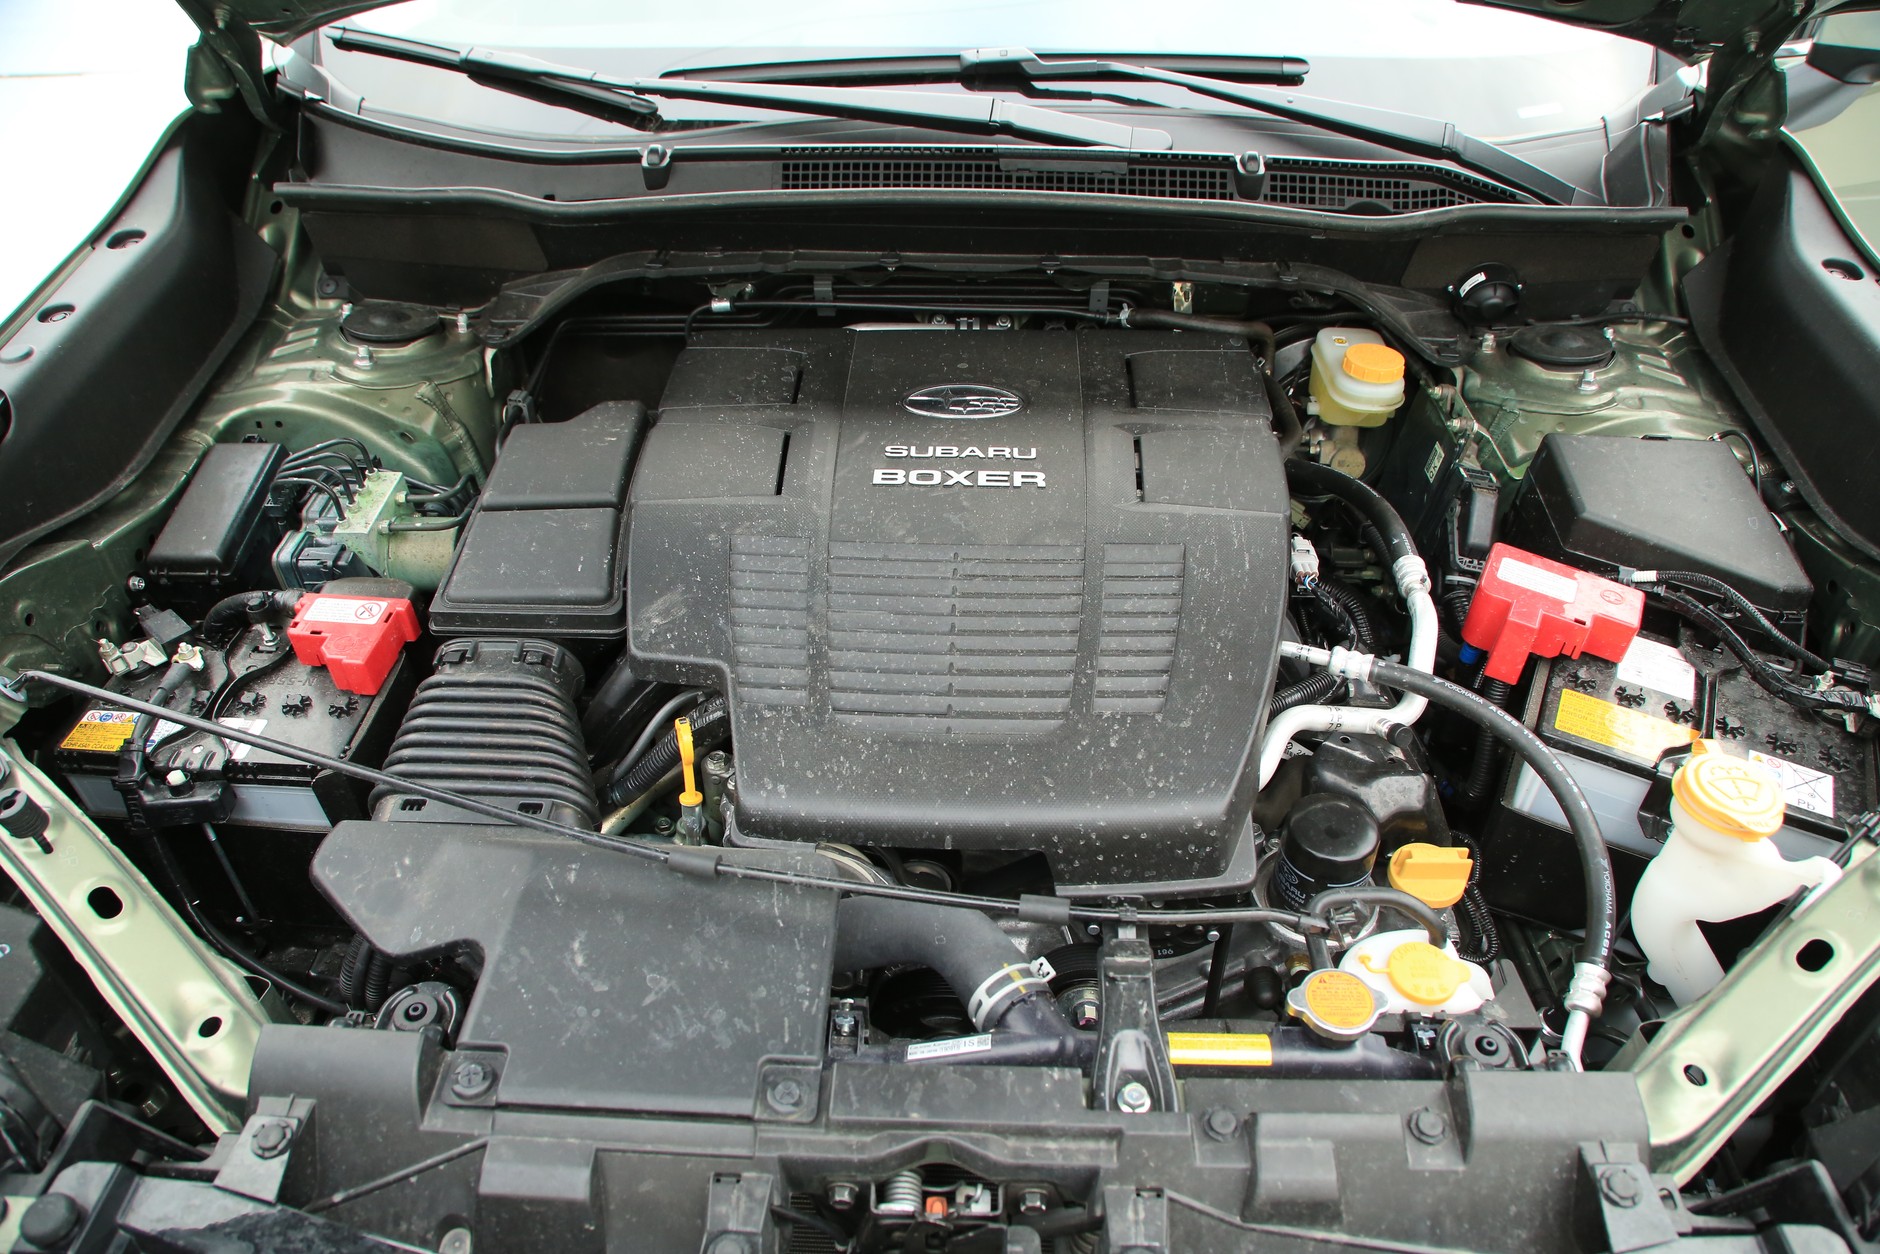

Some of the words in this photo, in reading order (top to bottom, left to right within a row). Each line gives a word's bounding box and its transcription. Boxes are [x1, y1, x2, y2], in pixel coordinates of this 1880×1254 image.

[884, 444, 1038, 460] SUBARU
[872, 468, 1047, 489] BOXER
[1444, 682, 1483, 705] YOKOHAMA
[1797, 798, 1816, 811] Pb
[1603, 871, 1613, 914] YOKOHAMA
